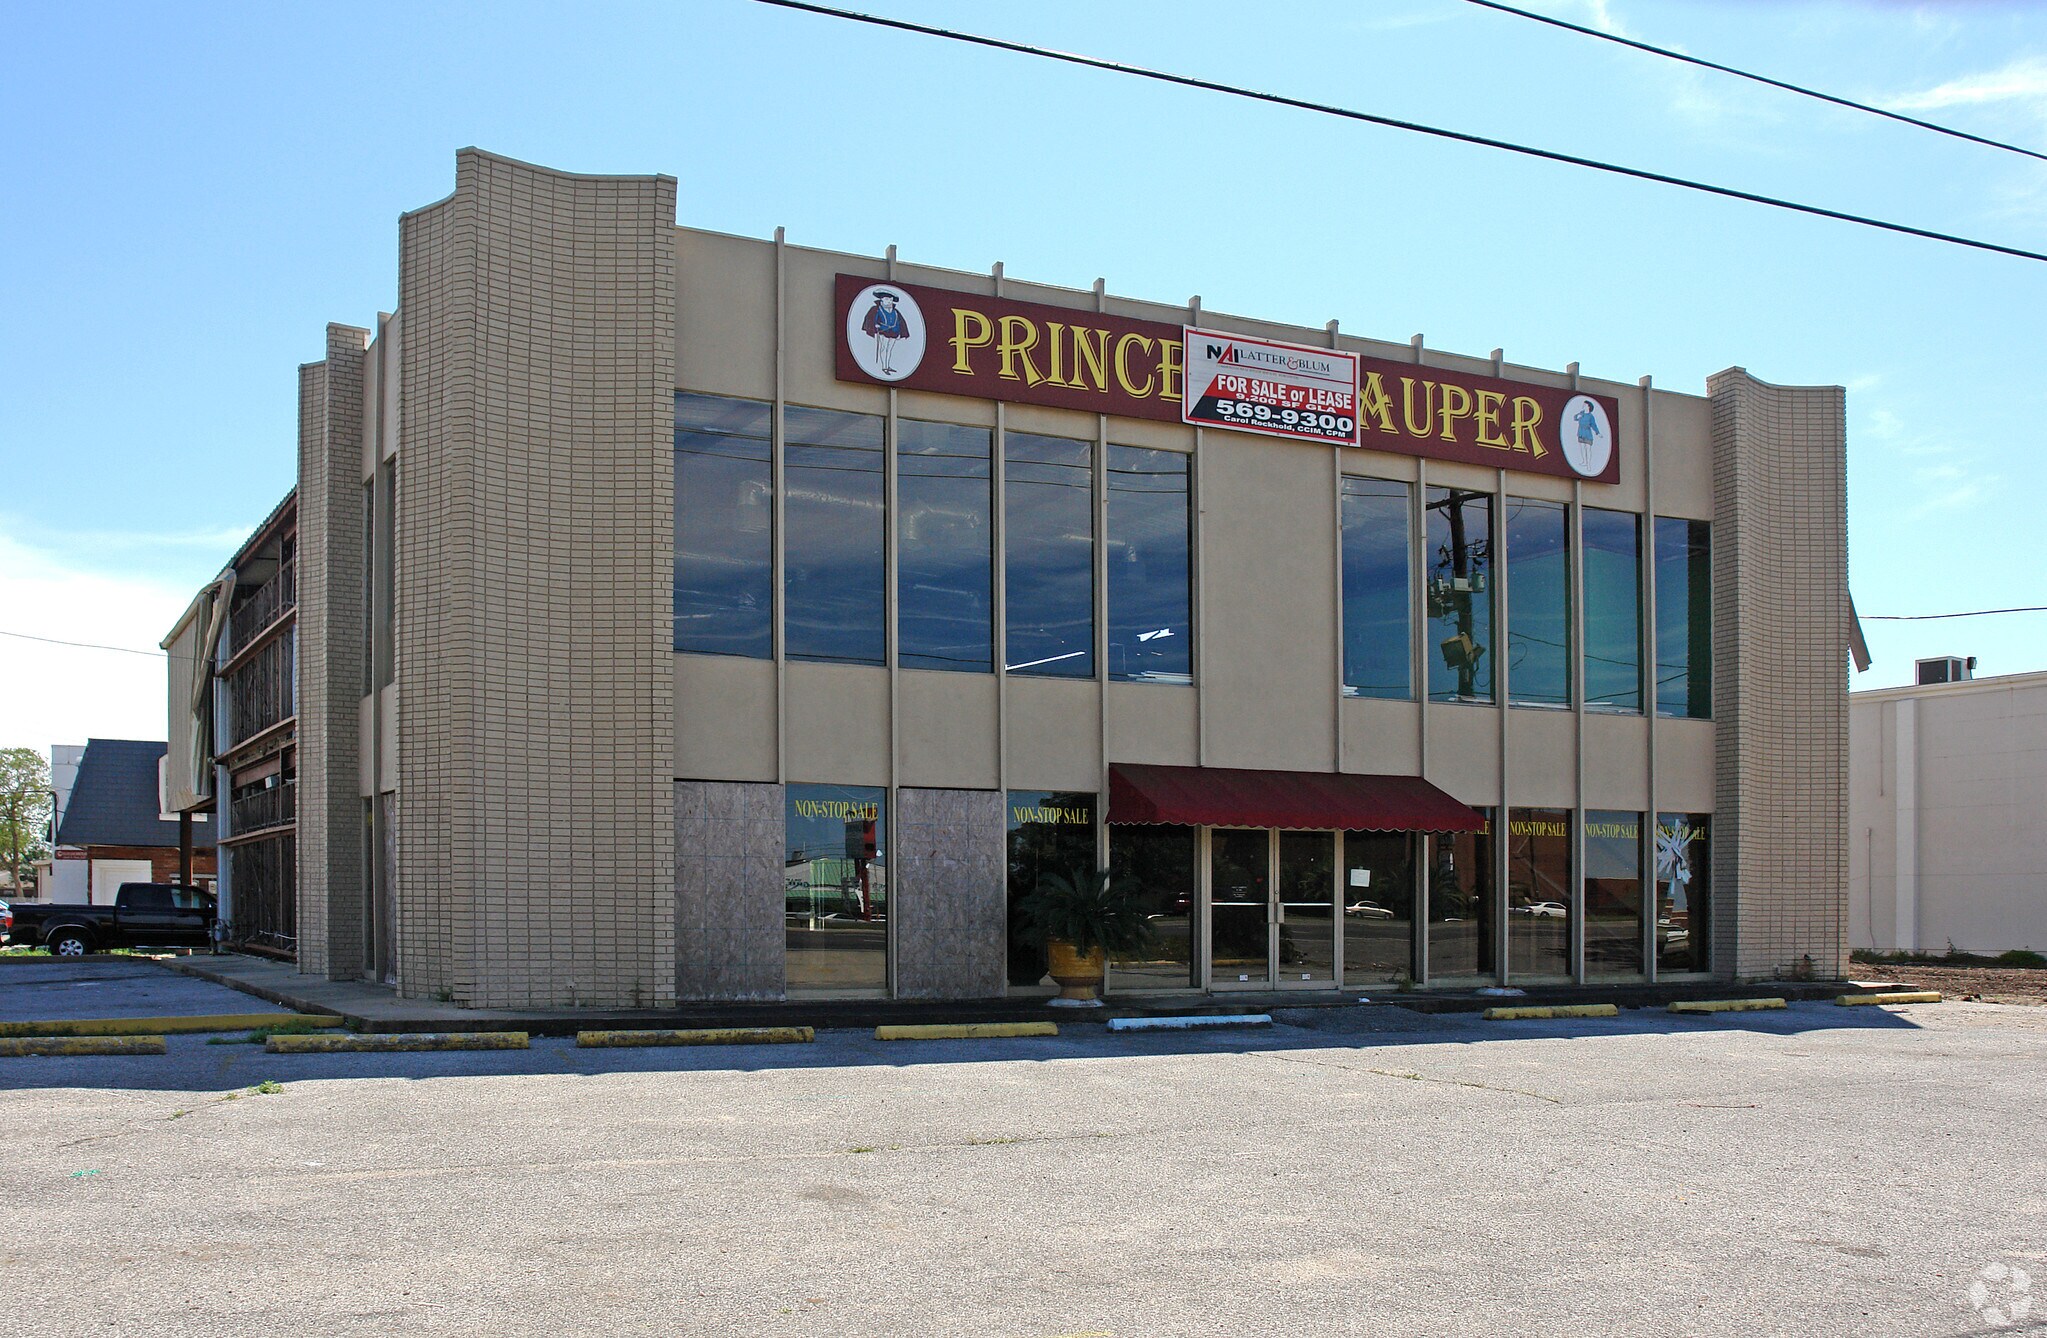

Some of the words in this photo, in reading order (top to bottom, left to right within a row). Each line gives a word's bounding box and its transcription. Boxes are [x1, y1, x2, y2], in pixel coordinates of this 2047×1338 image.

[1207, 342, 1239, 363] NAI
[948, 308, 1183, 403] PRINCE
[1360, 371, 1549, 459] AUPER
[1217, 374, 1248, 394] FOR
[1251, 379, 1287, 400] SALE
[1290, 389, 1306, 403] or
[1308, 388, 1352, 410] LEASE
[1235, 393, 1277, 405] 9,200
[1281, 400, 1300, 408] SF
[1305, 403, 1337, 413] GLA
[1216, 399, 1354, 432] 569-9300
[1223, 415, 1249, 424] Carol
[1251, 419, 1295, 432] Rockhold,
[1297, 426, 1324, 436] CCIM,
[1326, 429, 1346, 438] CPM
[795, 800, 849, 818] NON-STOP
[852, 801, 878, 818] SALE
[1013, 806, 1062, 824] NON-STOP
[1064, 807, 1089, 824] SALE
[1509, 821, 1547, 836] NON-STOP
[1547, 822, 1567, 837] SALE
[1585, 823, 1621, 838] NON-STOP
[1621, 824, 1639, 839] SALE
